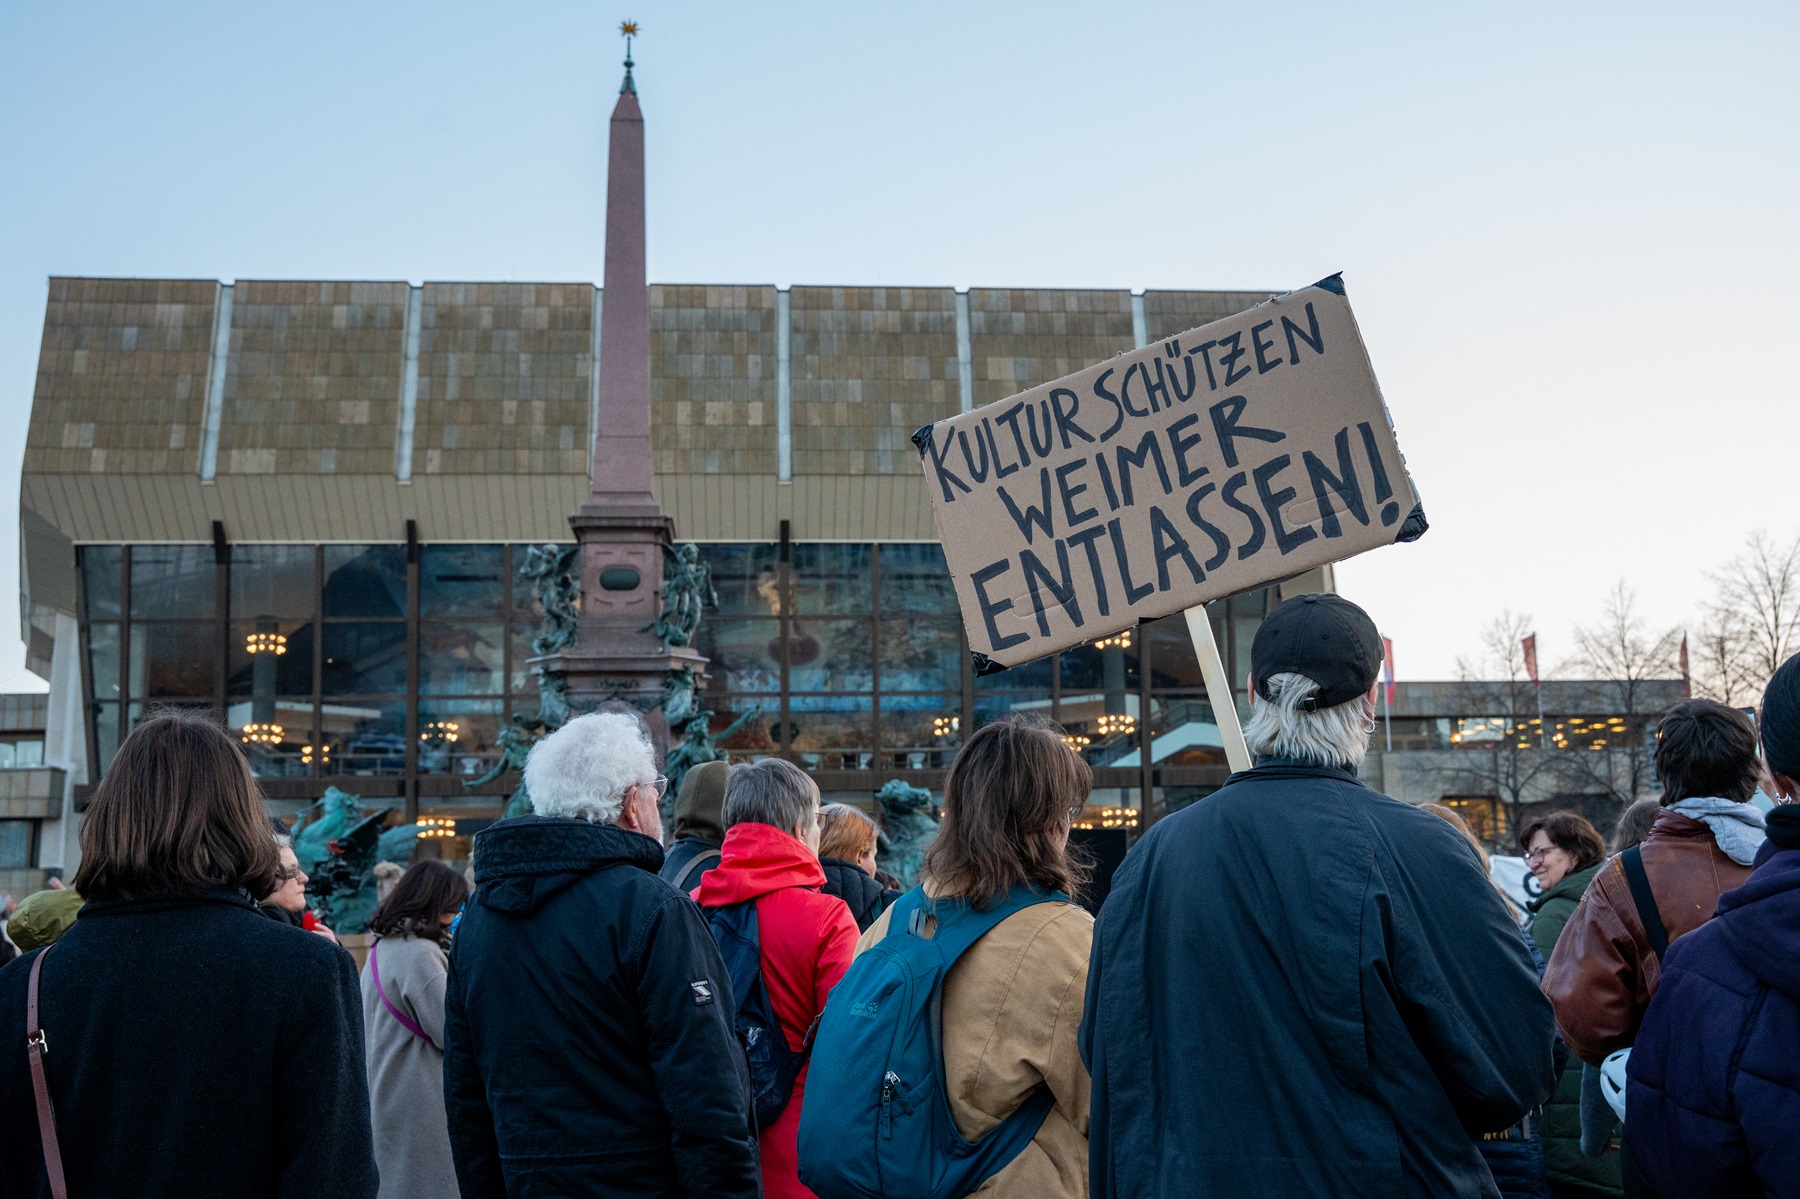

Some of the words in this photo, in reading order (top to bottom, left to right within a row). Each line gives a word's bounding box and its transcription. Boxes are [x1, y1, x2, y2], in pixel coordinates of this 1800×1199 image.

[930, 388, 1096, 502] KULTUR
[1095, 302, 1324, 443] SCHÜTZEN
[995, 395, 1286, 545] WEIMER
[970, 421, 1400, 652] ENTLASSEN!
